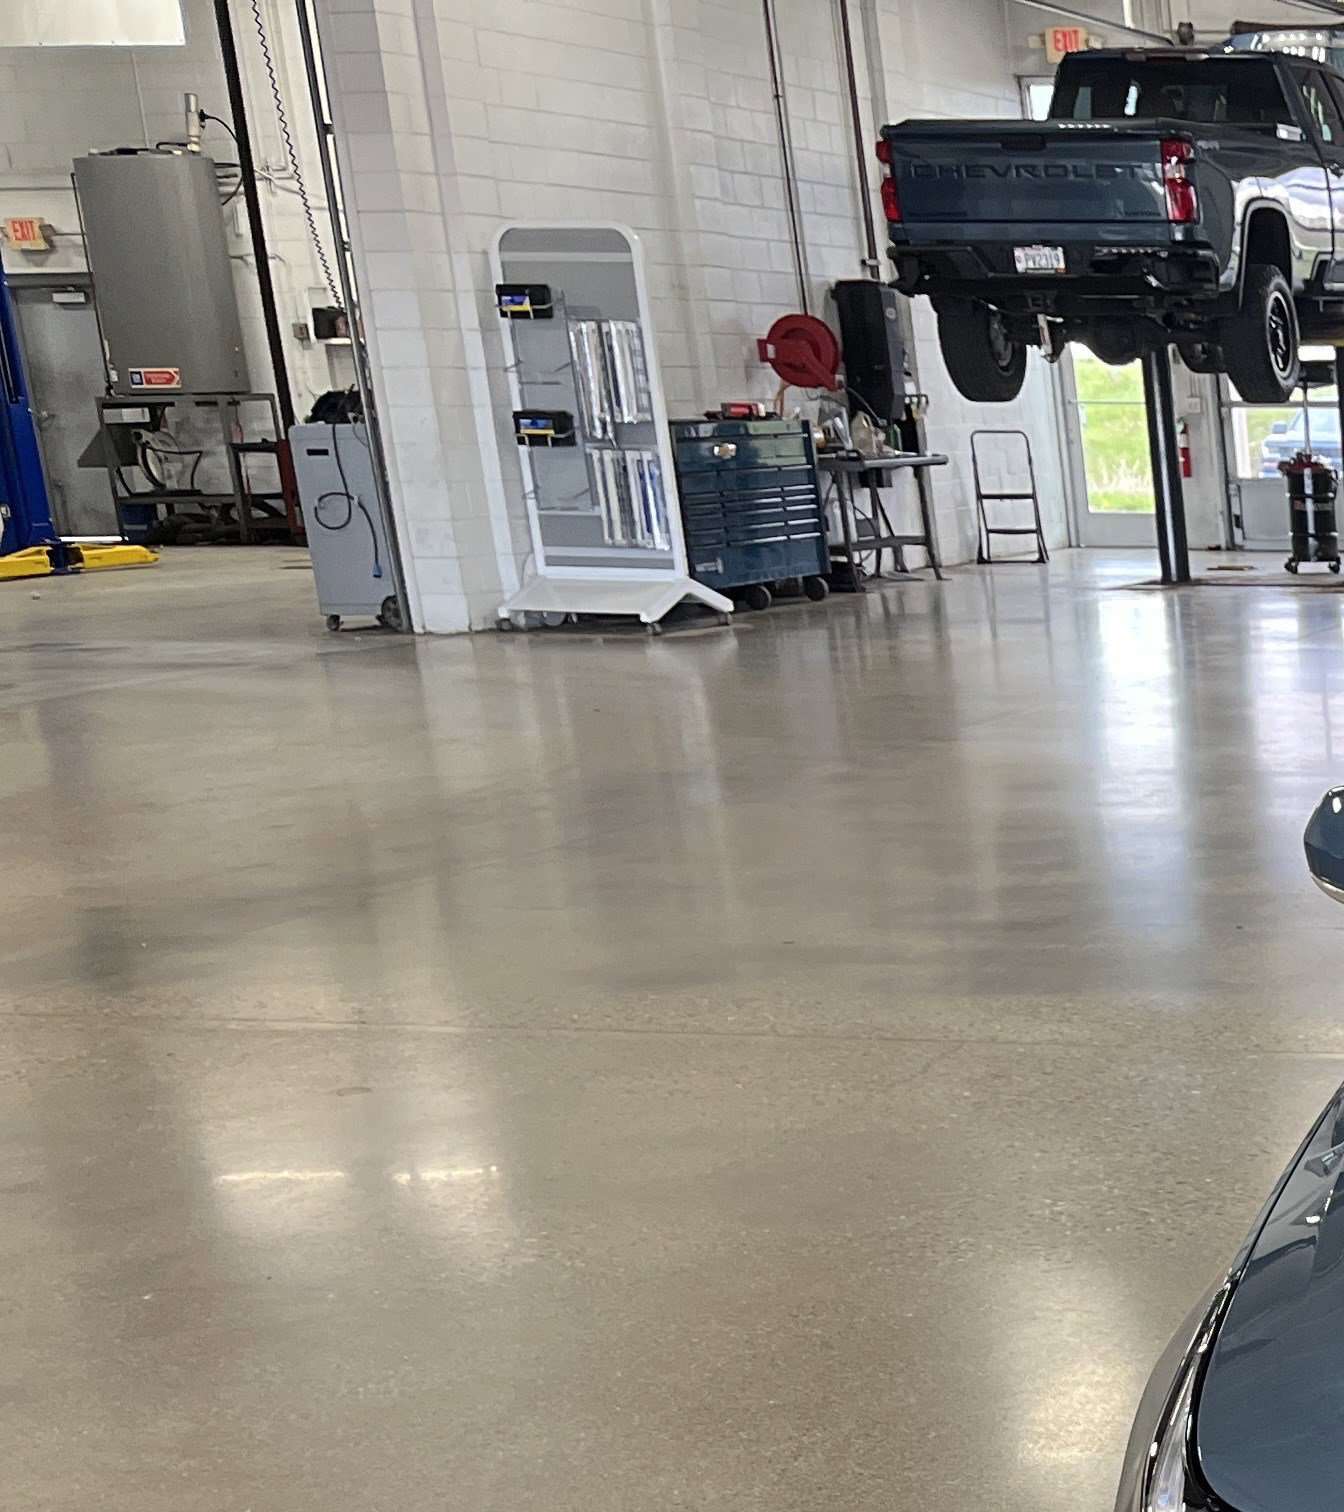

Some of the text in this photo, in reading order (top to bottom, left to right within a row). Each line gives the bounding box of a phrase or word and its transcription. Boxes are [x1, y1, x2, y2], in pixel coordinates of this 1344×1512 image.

[1053, 29, 1079, 51] EXIT
[910, 161, 1142, 181] CHEVROLET
[11, 219, 37, 241] EXIT
